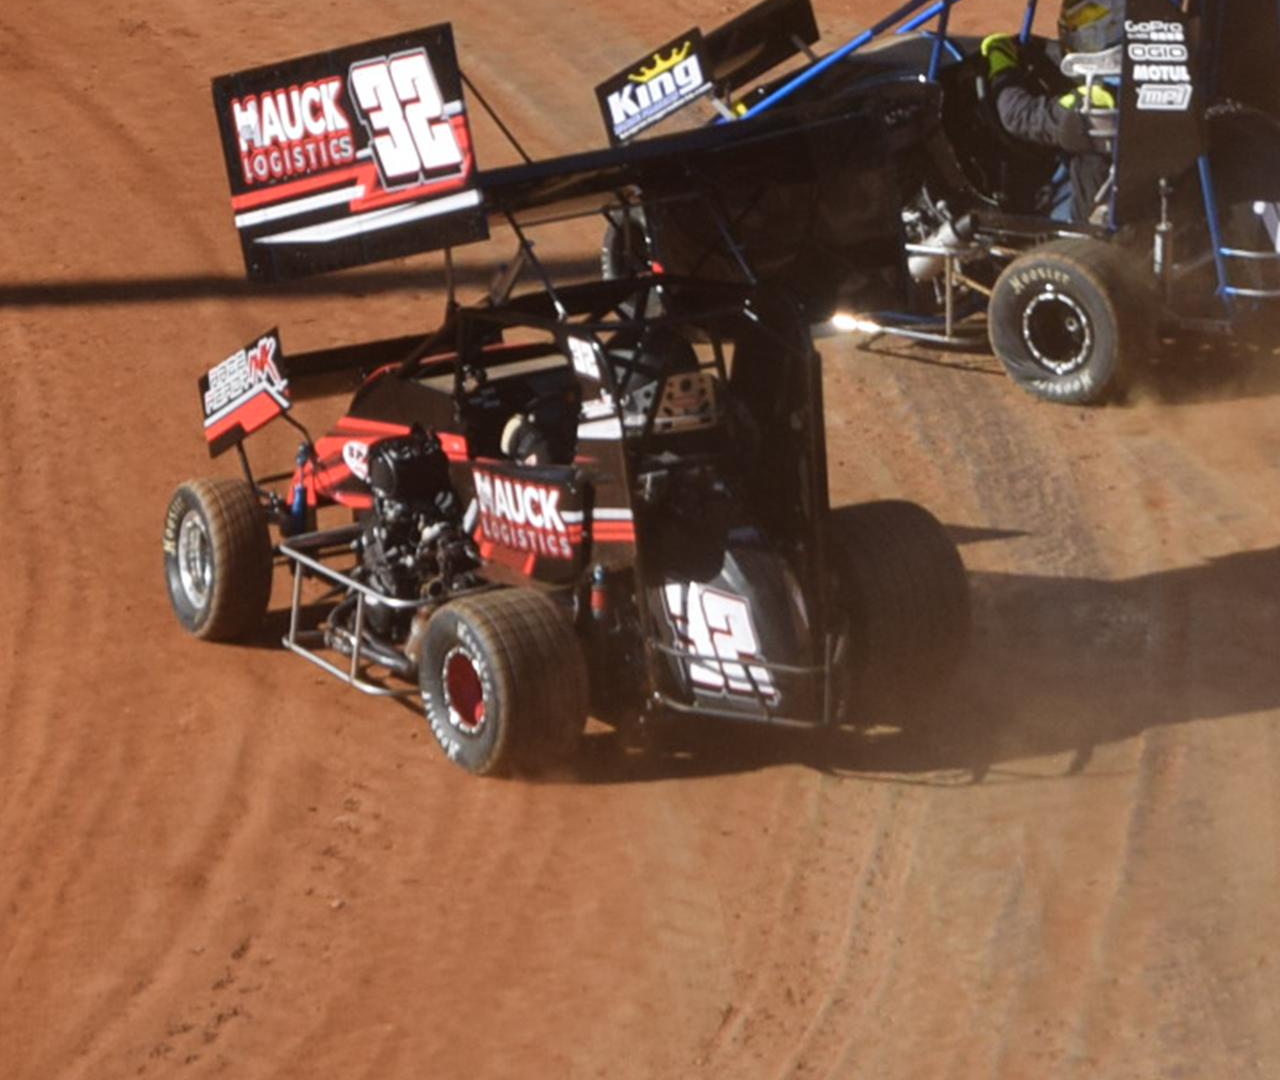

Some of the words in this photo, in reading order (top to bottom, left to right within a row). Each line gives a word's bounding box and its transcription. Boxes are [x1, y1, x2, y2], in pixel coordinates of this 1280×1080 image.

[1124, 20, 1183, 32] GoPro
[1129, 44, 1188, 60] OGIO
[1133, 64, 1191, 81] MOTUL
[607, 54, 703, 124] King
[349, 48, 467, 192] 32
[241, 133, 354, 182] LOGISTICS
[482, 518, 573, 559] LOGISTICS
